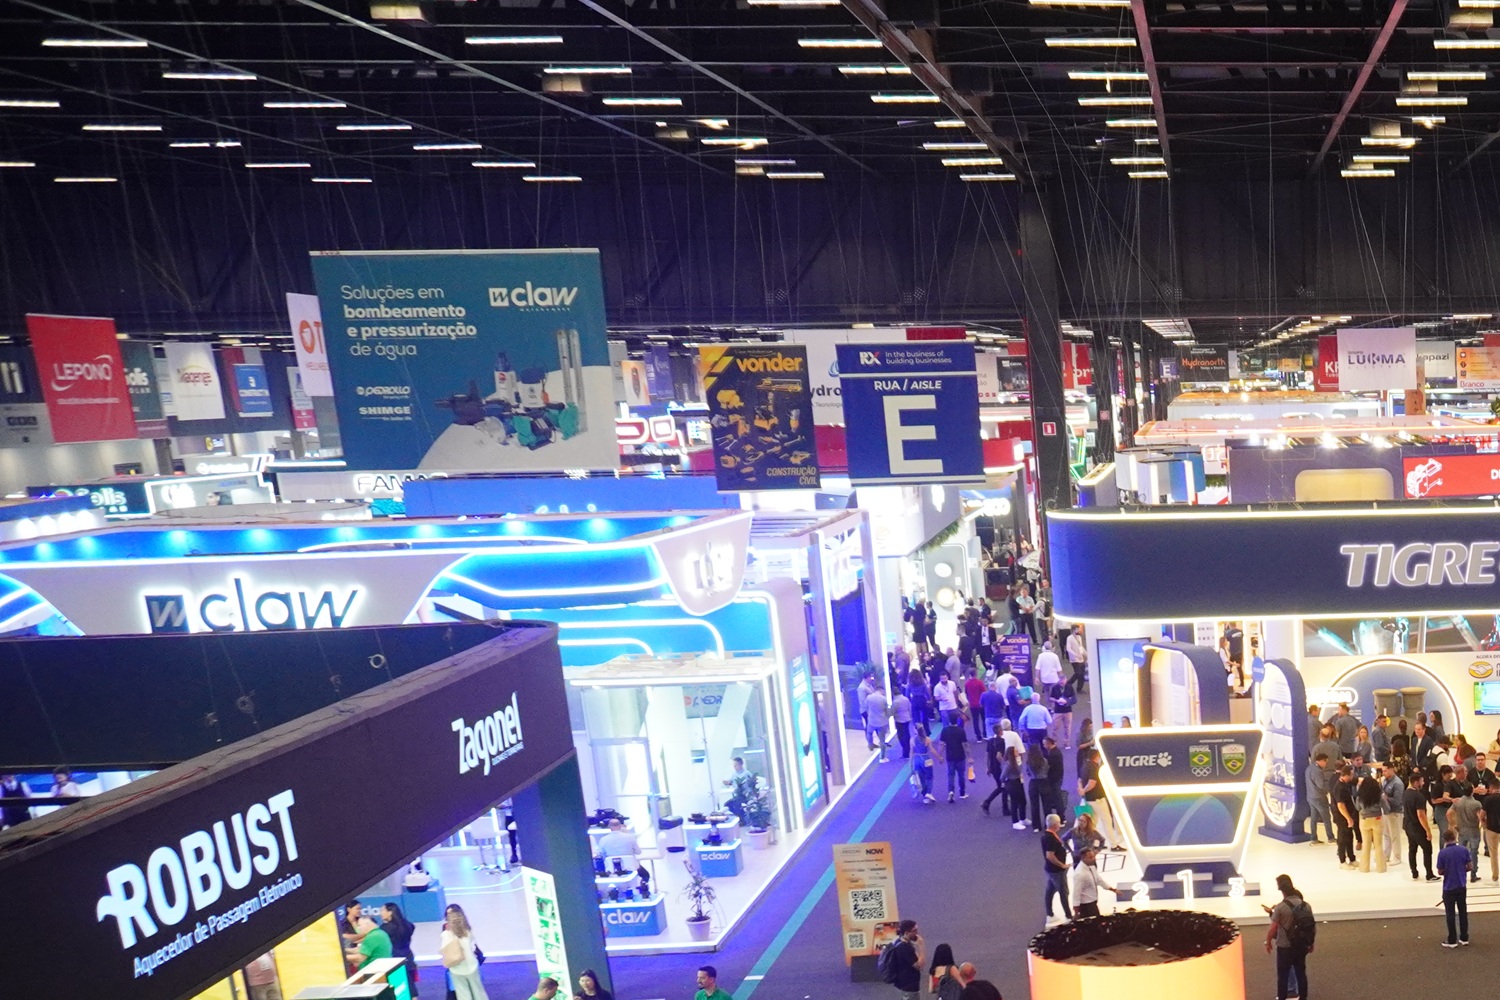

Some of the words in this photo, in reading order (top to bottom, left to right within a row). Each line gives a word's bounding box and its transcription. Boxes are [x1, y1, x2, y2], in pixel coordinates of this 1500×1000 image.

[341, 284, 414, 303] Soluções
[418, 287, 445, 299] em
[511, 281, 578, 307] claw
[344, 304, 466, 318] bombeamento
[347, 326, 358, 337] e
[361, 322, 477, 340] pressurização
[350, 343, 371, 356] de
[375, 342, 417, 360] água
[859, 351, 882, 366] RX
[906, 350, 936, 358] business
[736, 353, 803, 373] vonder
[886, 357, 914, 366] building
[915, 356, 952, 365] businesses
[53, 363, 112, 381] LEPONO
[874, 380, 900, 391] RUA
[910, 380, 942, 390] AISLE
[1460, 380, 1485, 388] Branco
[359, 407, 411, 416] SHIMGE
[882, 395, 944, 475] E
[767, 466, 817, 479] CONSTRUÇÃO
[799, 476, 817, 486] CIVIL
[1340, 541, 1500, 588] TIGRE
[199, 579, 360, 632] claw
[451, 691, 523, 776] Zagonel
[1116, 755, 1157, 768] TIGRE
[708, 852, 731, 861] claw
[97, 789, 298, 950] ROBUST
[1132, 882, 1150, 900] 2
[1177, 869, 1194, 899] 1
[1228, 877, 1245, 897] 3
[133, 931, 195, 979] Aquecedor
[194, 921, 209, 944] de
[208, 897, 260, 936] Passagem
[259, 873, 303, 907] Eletrônico
[607, 909, 650, 925] claw
